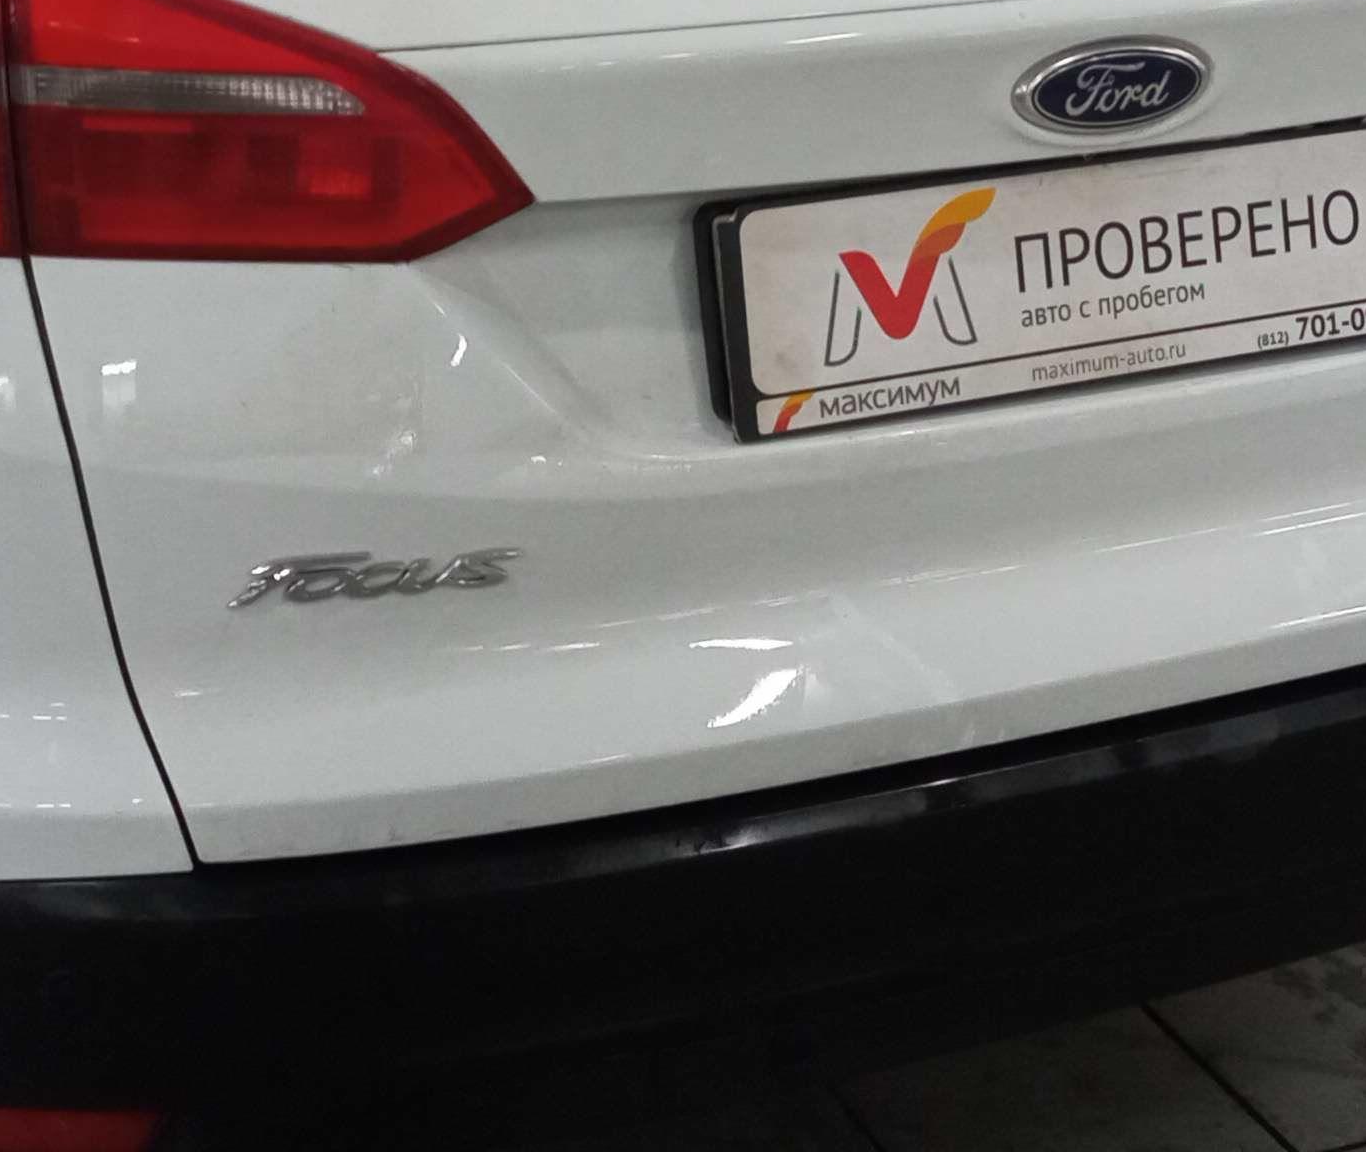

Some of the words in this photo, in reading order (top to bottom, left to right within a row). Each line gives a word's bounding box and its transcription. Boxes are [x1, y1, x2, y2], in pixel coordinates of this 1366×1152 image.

[1065, 62, 1171, 117] Ford
[1014, 189, 1360, 293] ПРОВЕРЕНО
[1021, 304, 1072, 328] авто
[1079, 300, 1091, 319] с
[1098, 281, 1206, 321] пробегом
[1257, 329, 1290, 350] (812)
[1031, 342, 1187, 383] maximum-auto.ru
[819, 377, 962, 419] максимум
